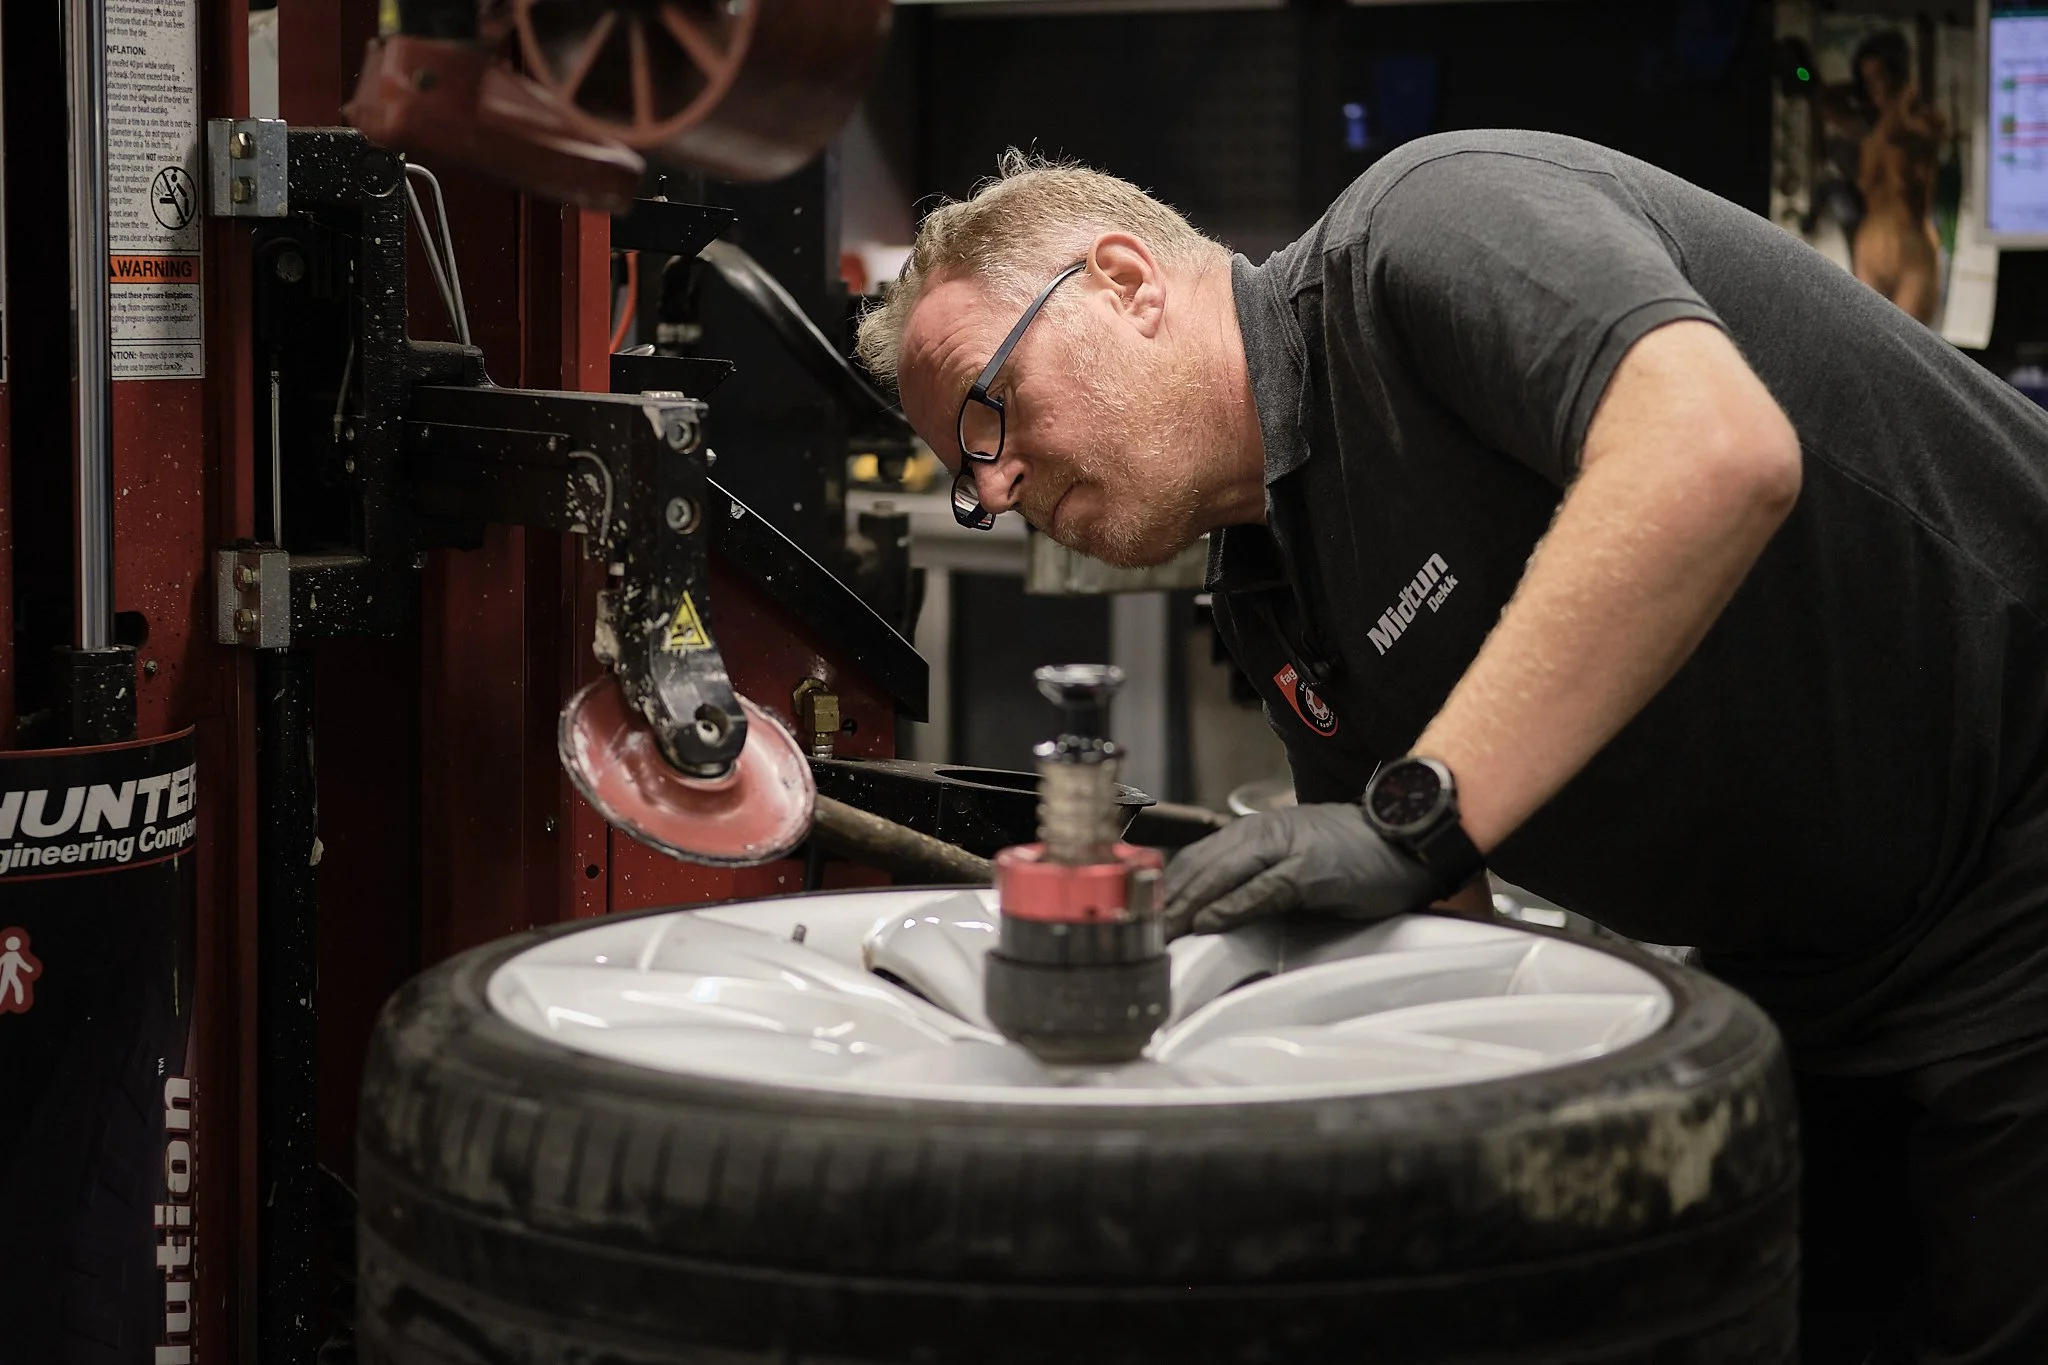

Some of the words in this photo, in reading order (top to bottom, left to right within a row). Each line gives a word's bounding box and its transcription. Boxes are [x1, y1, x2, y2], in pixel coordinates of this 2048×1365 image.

[107, 45, 146, 55] NFLATION:
[118, 260, 192, 277] WARNING
[1367, 552, 1449, 656] Midtun
[1426, 574, 1459, 613] Dekk
[1280, 668, 1298, 686] fag
[0, 762, 196, 839] UNTER
[0, 835, 136, 874] gineering
[138, 816, 196, 853] Compa
[154, 1076, 190, 1365] lution
